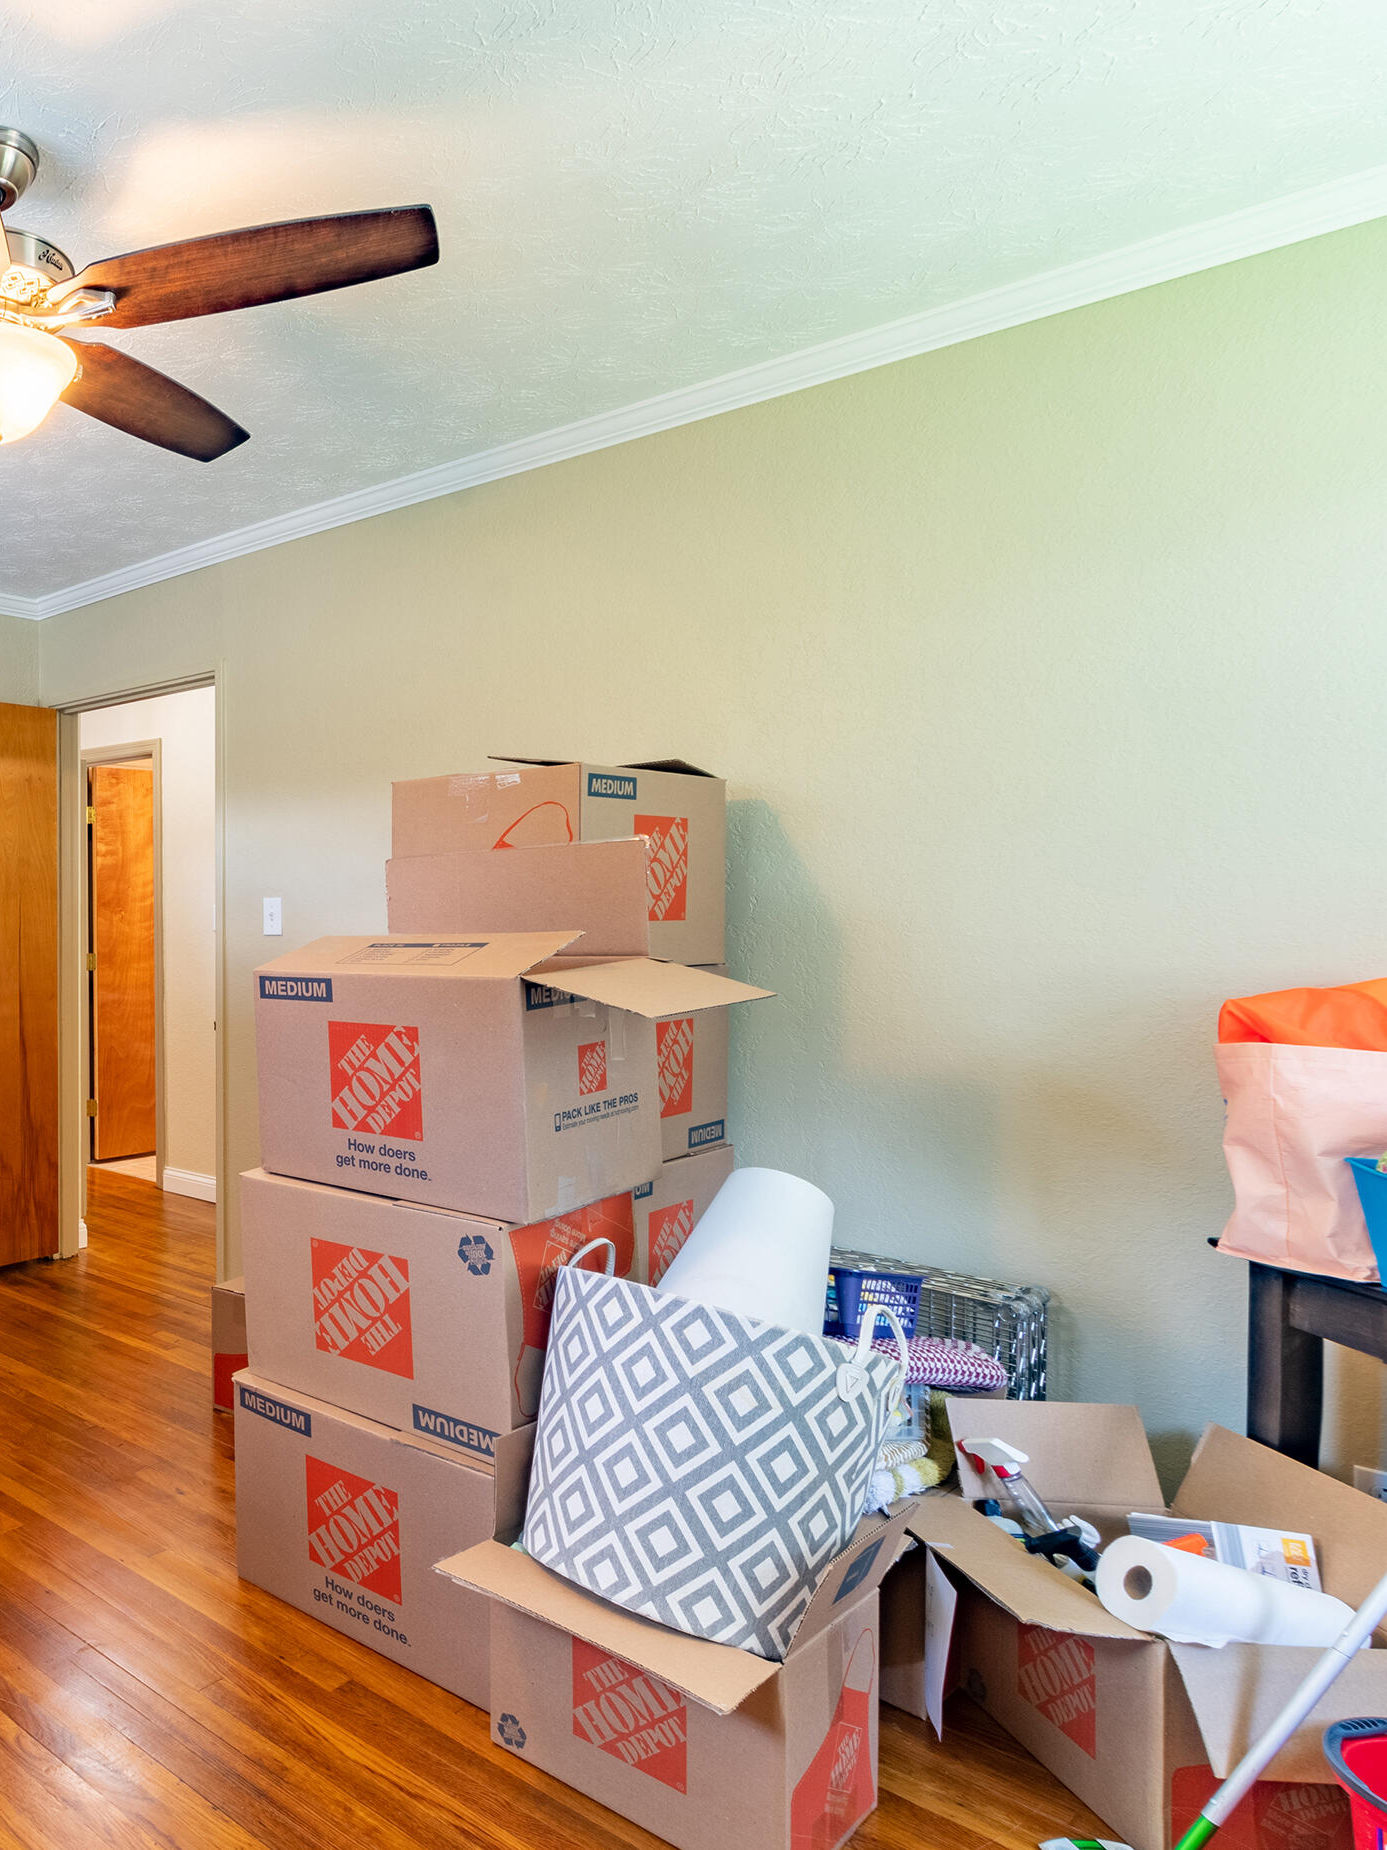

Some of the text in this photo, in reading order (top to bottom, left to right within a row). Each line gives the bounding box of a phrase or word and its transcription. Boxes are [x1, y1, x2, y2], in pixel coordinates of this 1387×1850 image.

[591, 778, 634, 796] MEDIUM
[654, 855, 687, 920] DEPOT
[265, 980, 326, 997] MEDIUM
[338, 1034, 374, 1076] THE
[579, 1041, 606, 1095] HOME
[332, 1025, 420, 1130] HOME
[671, 1068, 689, 1105] THE
[366, 1069, 421, 1134] DEPOT
[562, 1092, 639, 1121] PACK LIKE THE PROS
[348, 1138, 415, 1161] How doers
[691, 1125, 723, 1145] MEDIUM
[336, 1154, 355, 1167] get
[359, 1158, 391, 1174] more
[653, 1216, 672, 1256] THE
[313, 1248, 370, 1310] DEPOT
[314, 1253, 410, 1355] HOME
[361, 1313, 403, 1356] THE
[244, 1392, 306, 1431] MEDIUM
[418, 1410, 495, 1452] MEDIUM
[315, 1479, 352, 1517] THE
[308, 1483, 399, 1569] HOME
[343, 1531, 401, 1584] DEPOT
[313, 1587, 333, 1606] get
[337, 1600, 370, 1625] more
[325, 1576, 395, 1622] How doers
[582, 1659, 629, 1693] THE
[1019, 1639, 1094, 1703] HOME
[1047, 1684, 1095, 1724] DEPOT
[616, 1717, 686, 1765] DEPOT
